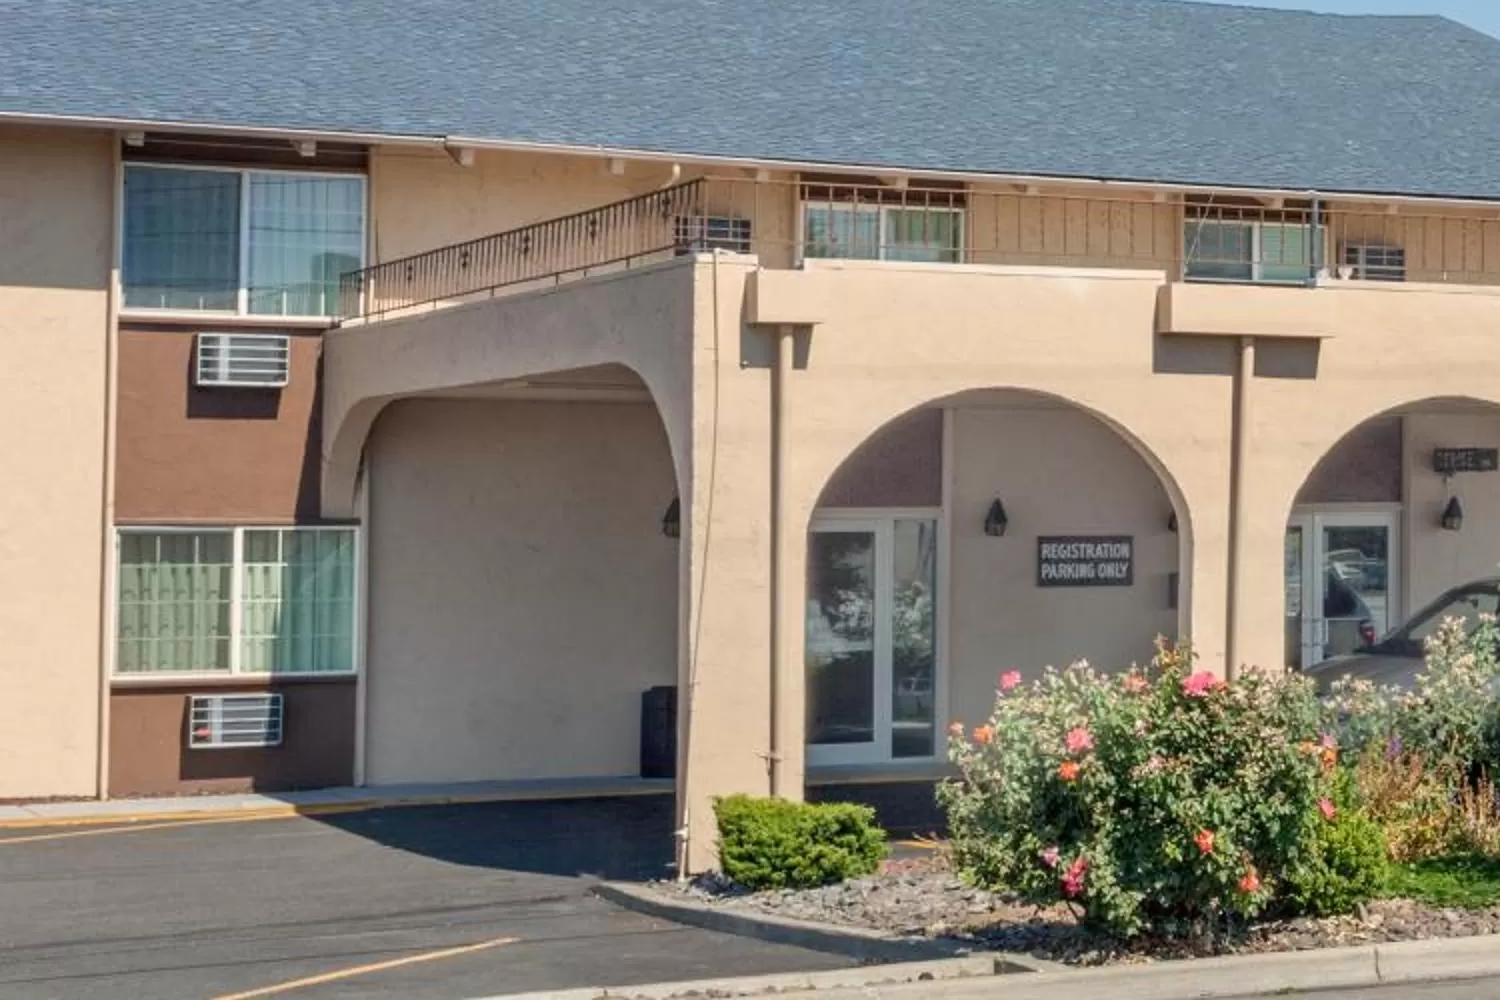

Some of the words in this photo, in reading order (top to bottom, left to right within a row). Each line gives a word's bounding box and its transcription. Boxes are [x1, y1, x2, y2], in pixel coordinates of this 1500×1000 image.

[1041, 543, 1130, 559] REGISTRATION
[1041, 562, 1095, 578] PARKING
[1097, 562, 1129, 577] ONLY
